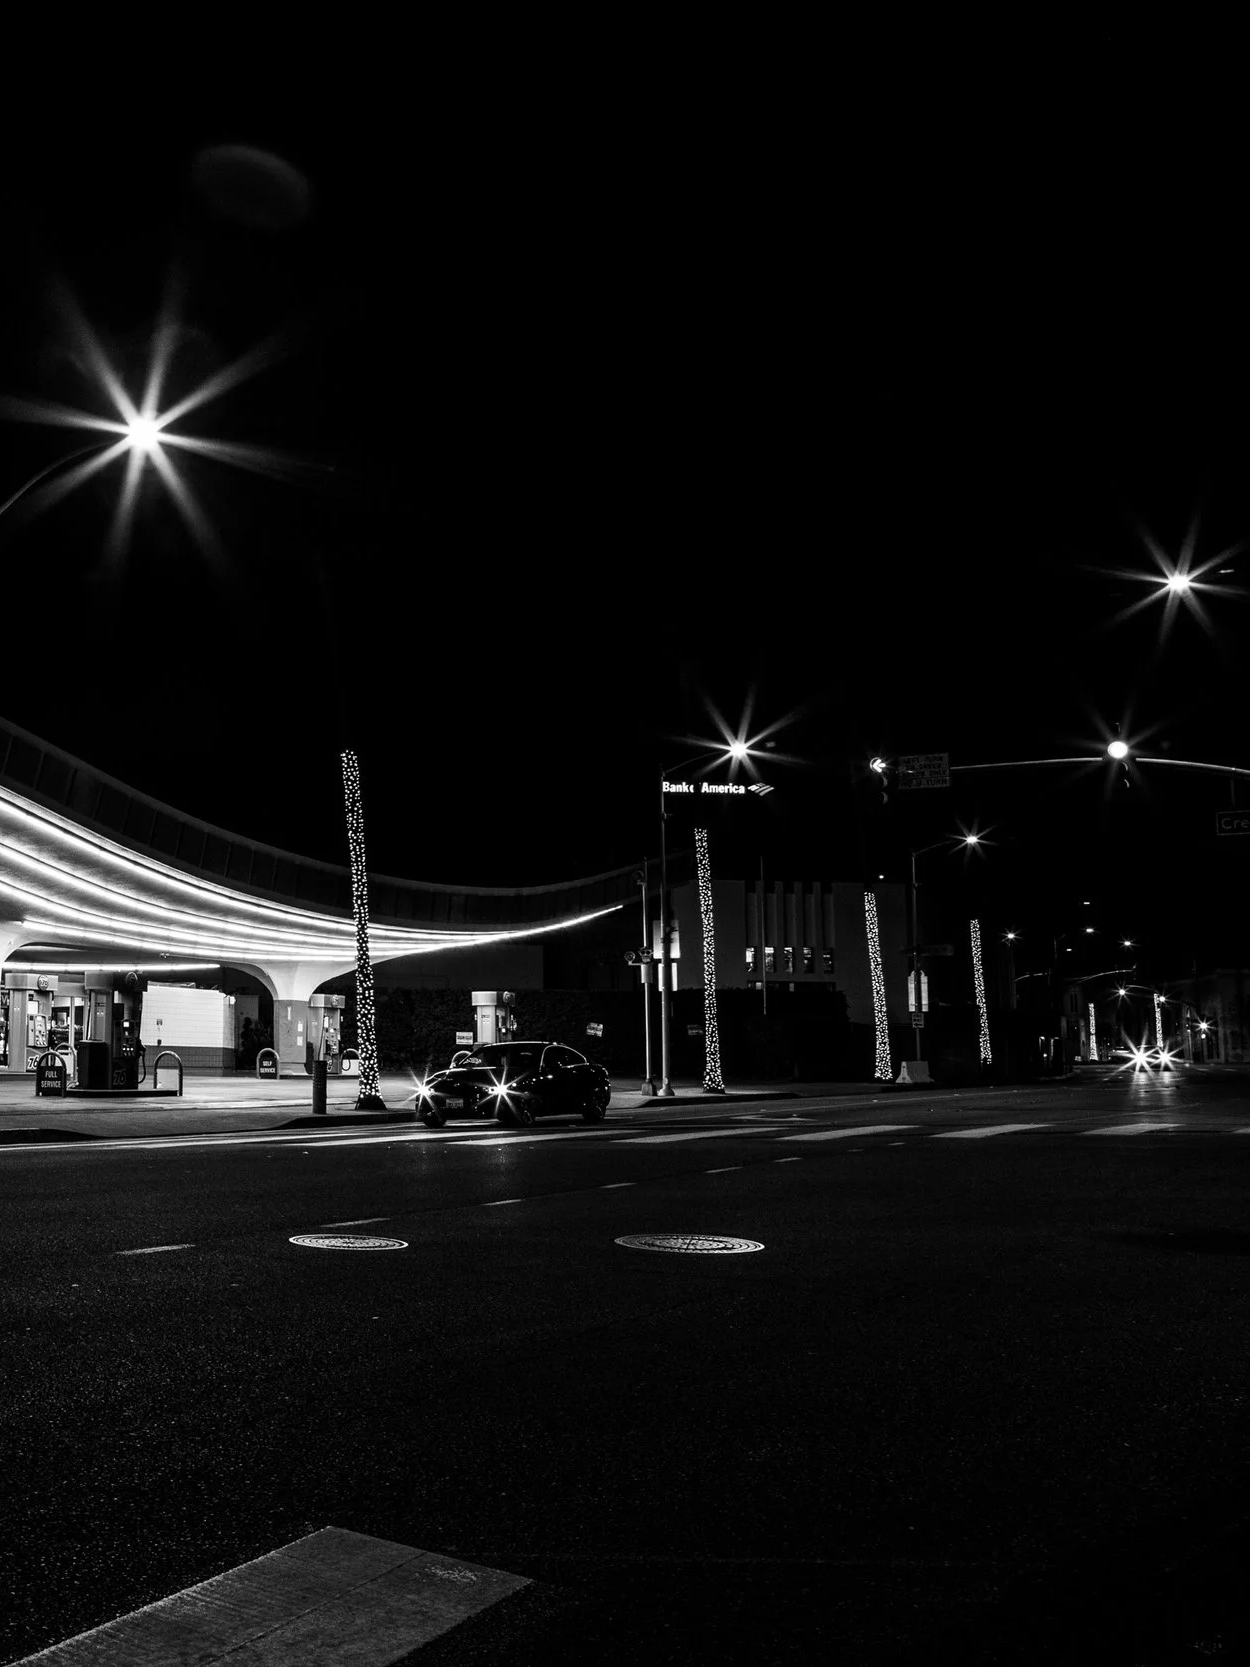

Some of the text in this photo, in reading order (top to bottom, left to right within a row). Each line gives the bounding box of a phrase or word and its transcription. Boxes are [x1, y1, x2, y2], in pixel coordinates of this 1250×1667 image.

[926, 778, 948, 786] TURN
[662, 781, 689, 793] Bank
[701, 782, 746, 794] America
[45, 1070, 58, 1078] FULL
[113, 1068, 126, 1085] 76
[40, 1080, 62, 1088] SERVICE
